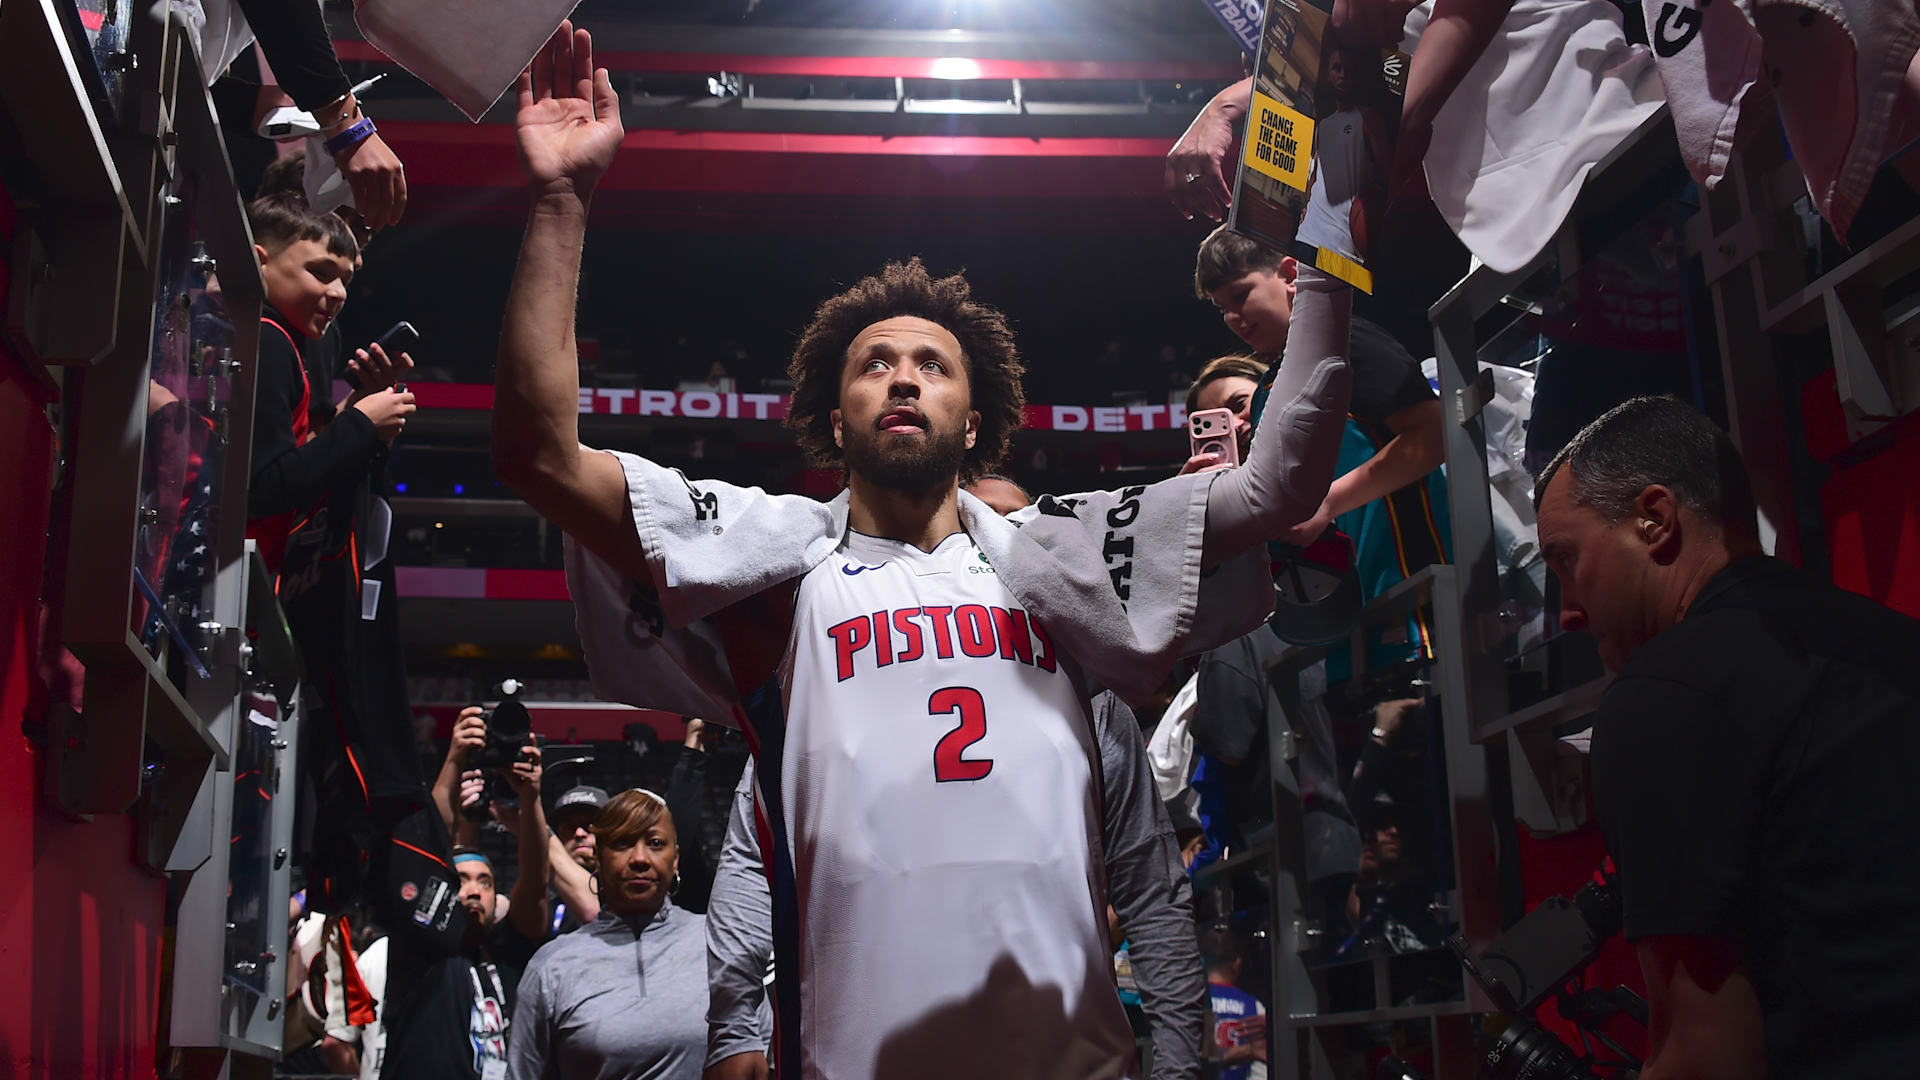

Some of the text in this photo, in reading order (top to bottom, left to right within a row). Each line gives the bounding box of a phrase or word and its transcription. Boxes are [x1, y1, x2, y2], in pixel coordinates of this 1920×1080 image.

[1261, 108, 1295, 137] CHANGE
[1255, 141, 1296, 174] FOR GOOD
[1259, 125, 1298, 157] THE GAME
[827, 604, 1057, 683] PISTONS
[928, 686, 994, 783] 2
